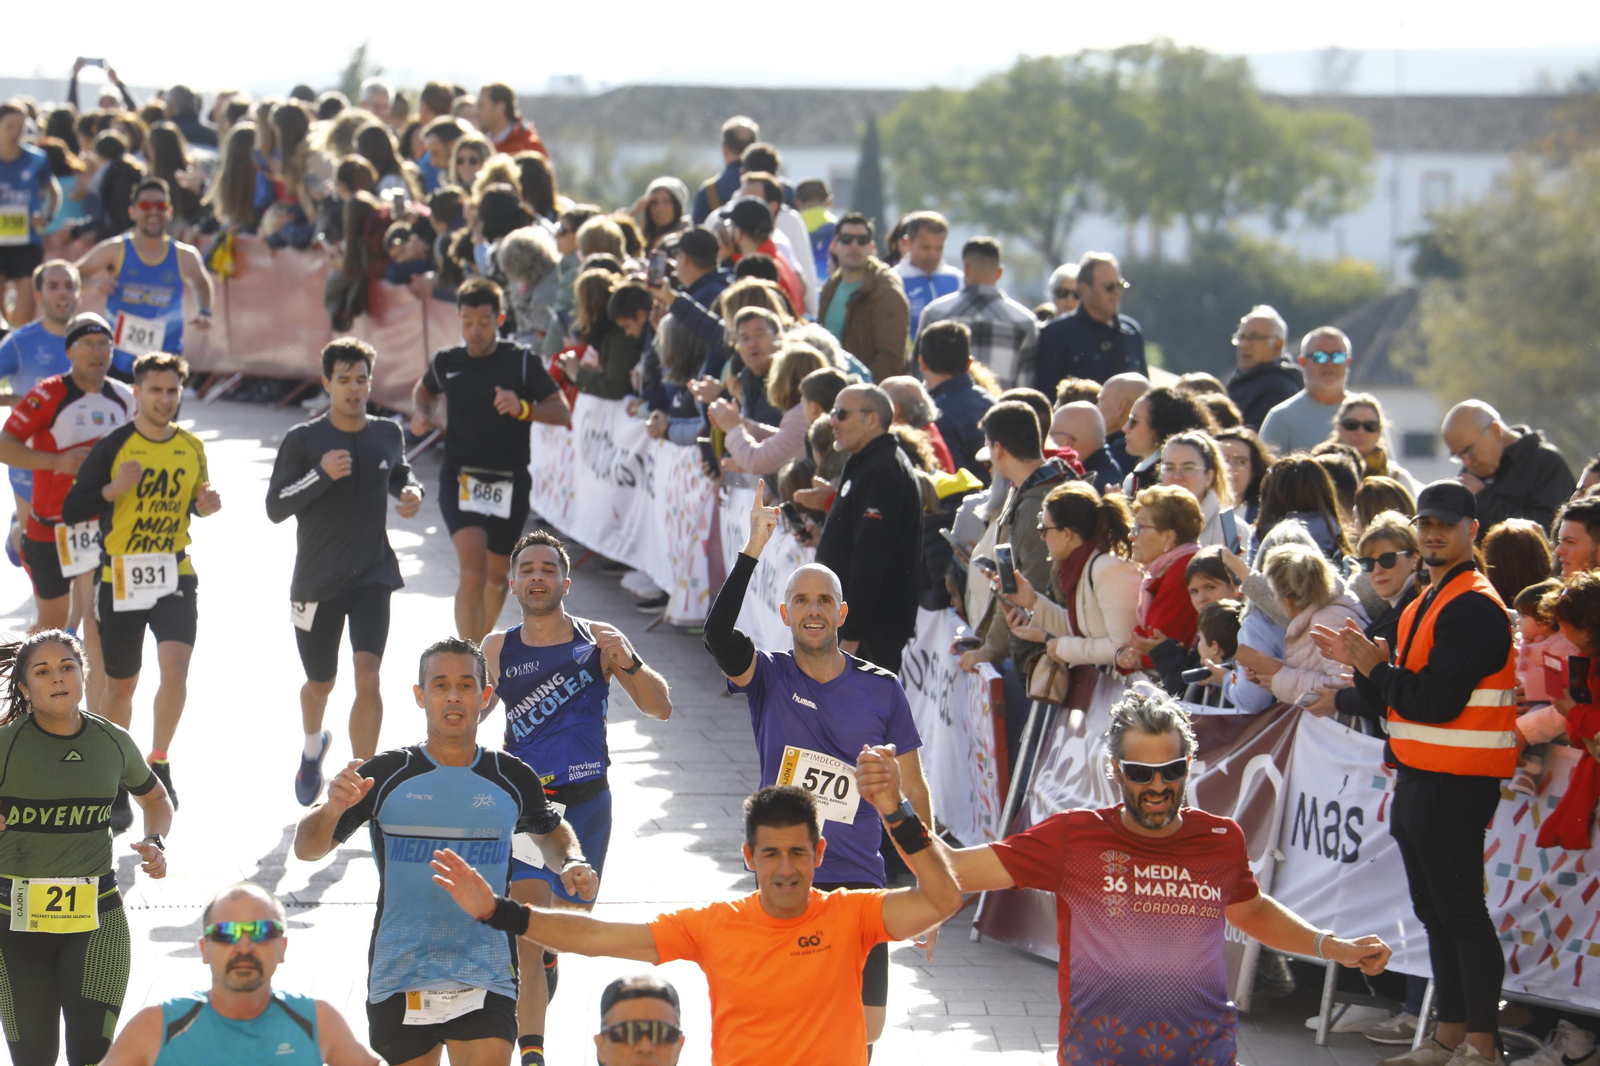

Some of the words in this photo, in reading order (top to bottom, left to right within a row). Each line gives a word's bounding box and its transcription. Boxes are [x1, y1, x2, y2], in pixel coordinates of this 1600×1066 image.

[127, 325, 155, 345] 201
[136, 468, 186, 499] GAS
[473, 483, 503, 503] 686
[69, 530, 102, 549] 184
[132, 565, 166, 585] 931
[511, 669, 594, 743] ALCOLEA
[810, 753, 841, 768] IMDECO
[802, 766, 850, 800] 570
[1133, 864, 1192, 881] MEDIA
[1102, 875, 1128, 893] 36
[1134, 880, 1222, 901] MARATÓN
[45, 886, 76, 912] 21
[1200, 906, 1220, 919] 2022
[798, 935, 820, 948] GO
